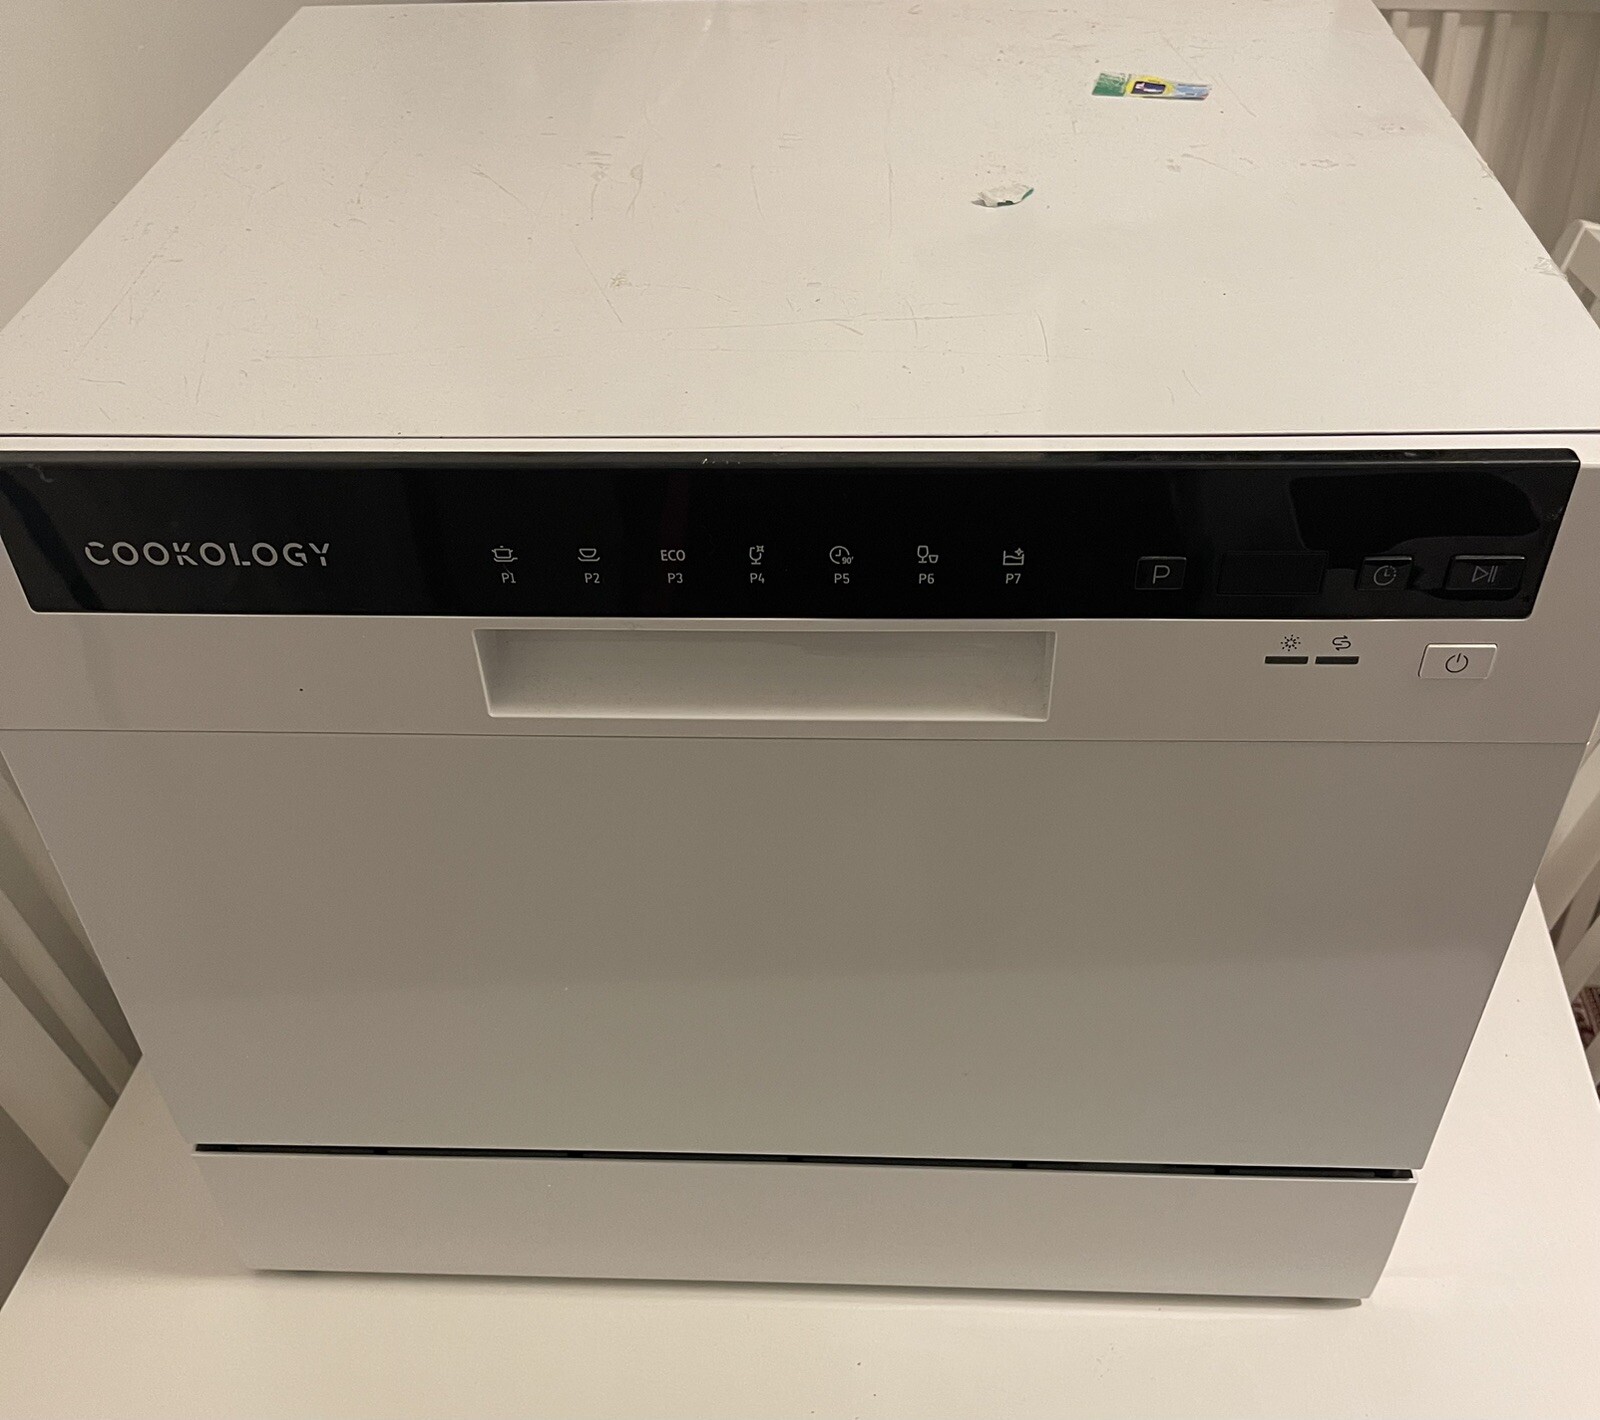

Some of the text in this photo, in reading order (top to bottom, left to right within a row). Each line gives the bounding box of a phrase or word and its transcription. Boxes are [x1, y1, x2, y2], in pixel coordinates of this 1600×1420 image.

[84, 541, 330, 567] COOKOLOGY
[660, 549, 686, 562] ECO
[501, 572, 517, 584] P1
[584, 572, 600, 584] P2
[667, 572, 684, 584] P3
[749, 572, 765, 584] P4
[834, 572, 850, 584] P5
[918, 573, 935, 585] P6
[1005, 573, 1021, 584] P7
[1152, 564, 1171, 584] P
